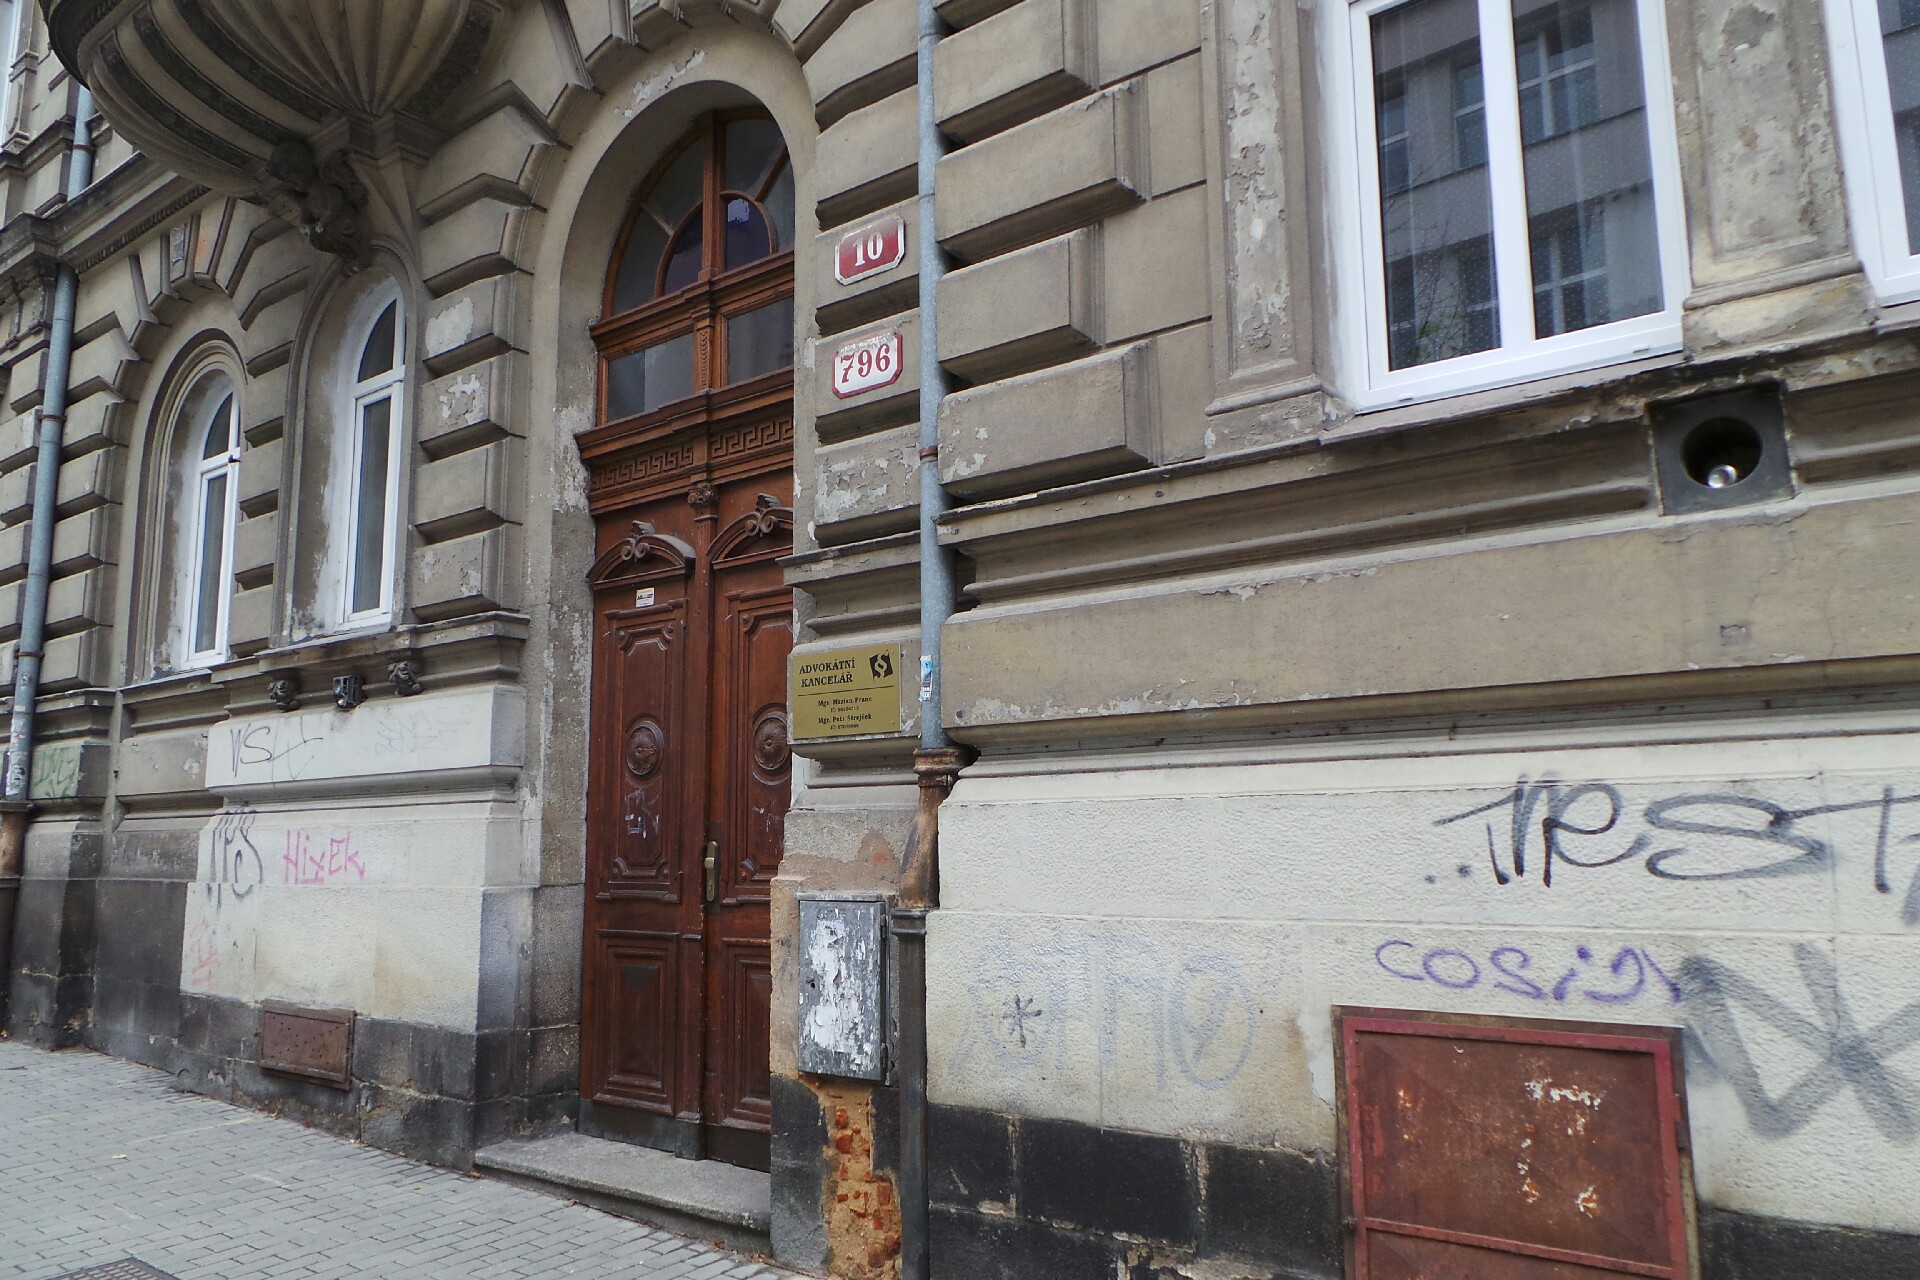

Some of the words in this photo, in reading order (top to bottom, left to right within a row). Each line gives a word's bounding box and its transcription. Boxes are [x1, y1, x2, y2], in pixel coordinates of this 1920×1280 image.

[853, 232, 883, 266] 10
[841, 343, 890, 384] 796
[799, 657, 855, 674] ADVOKÁTNÍ
[801, 672, 853, 687] KANCELÁŘ
[854, 696, 872, 704] Franc
[832, 715, 846, 723] Petr
